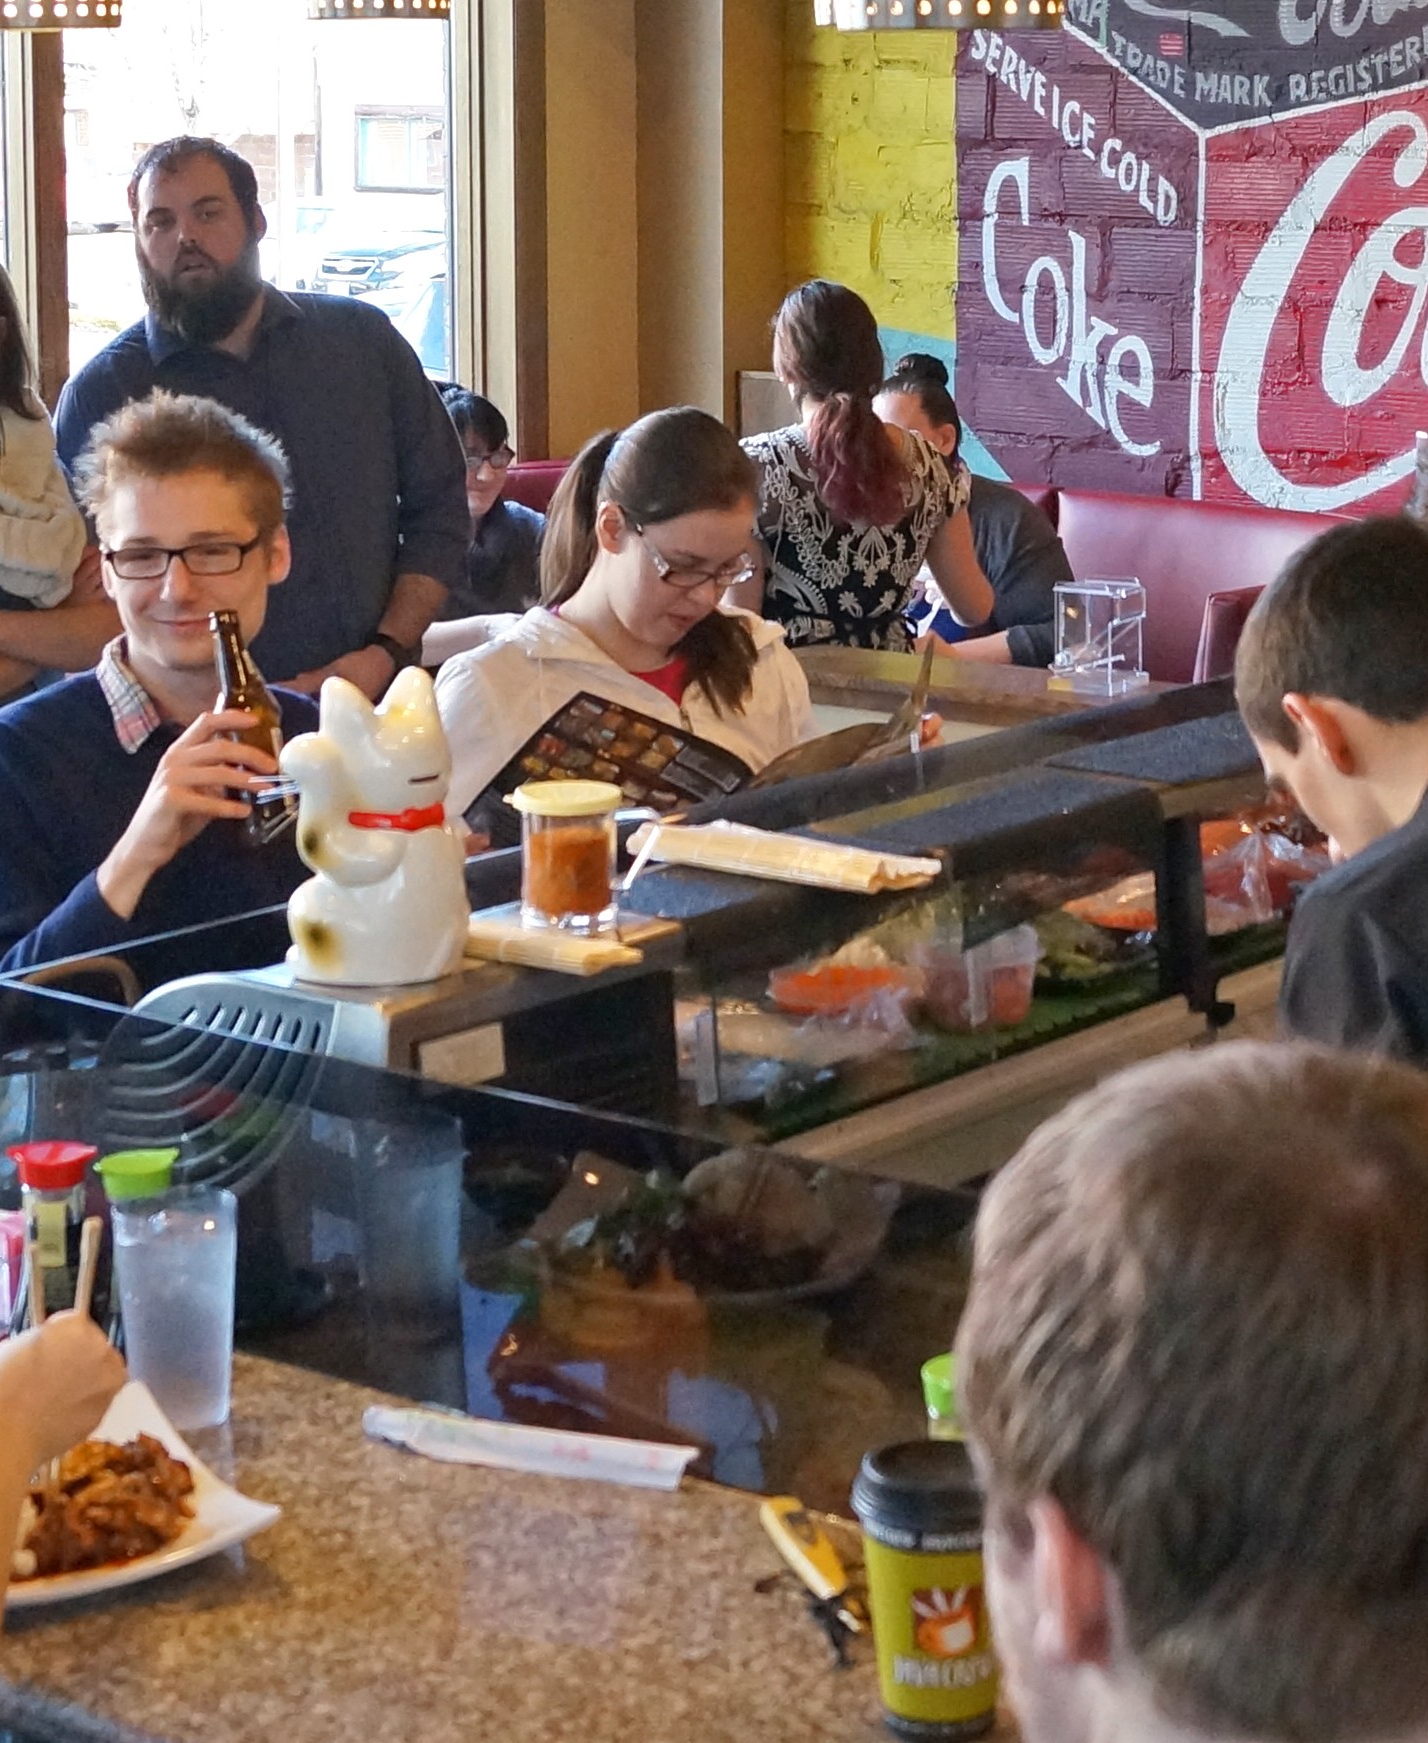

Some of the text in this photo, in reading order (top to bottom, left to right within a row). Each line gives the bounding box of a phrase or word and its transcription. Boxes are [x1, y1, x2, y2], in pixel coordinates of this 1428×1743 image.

[971, 28, 1178, 226] SERVE ICE COLD
[1194, 71, 1273, 107] MARK
[982, 156, 1161, 456] Coke
